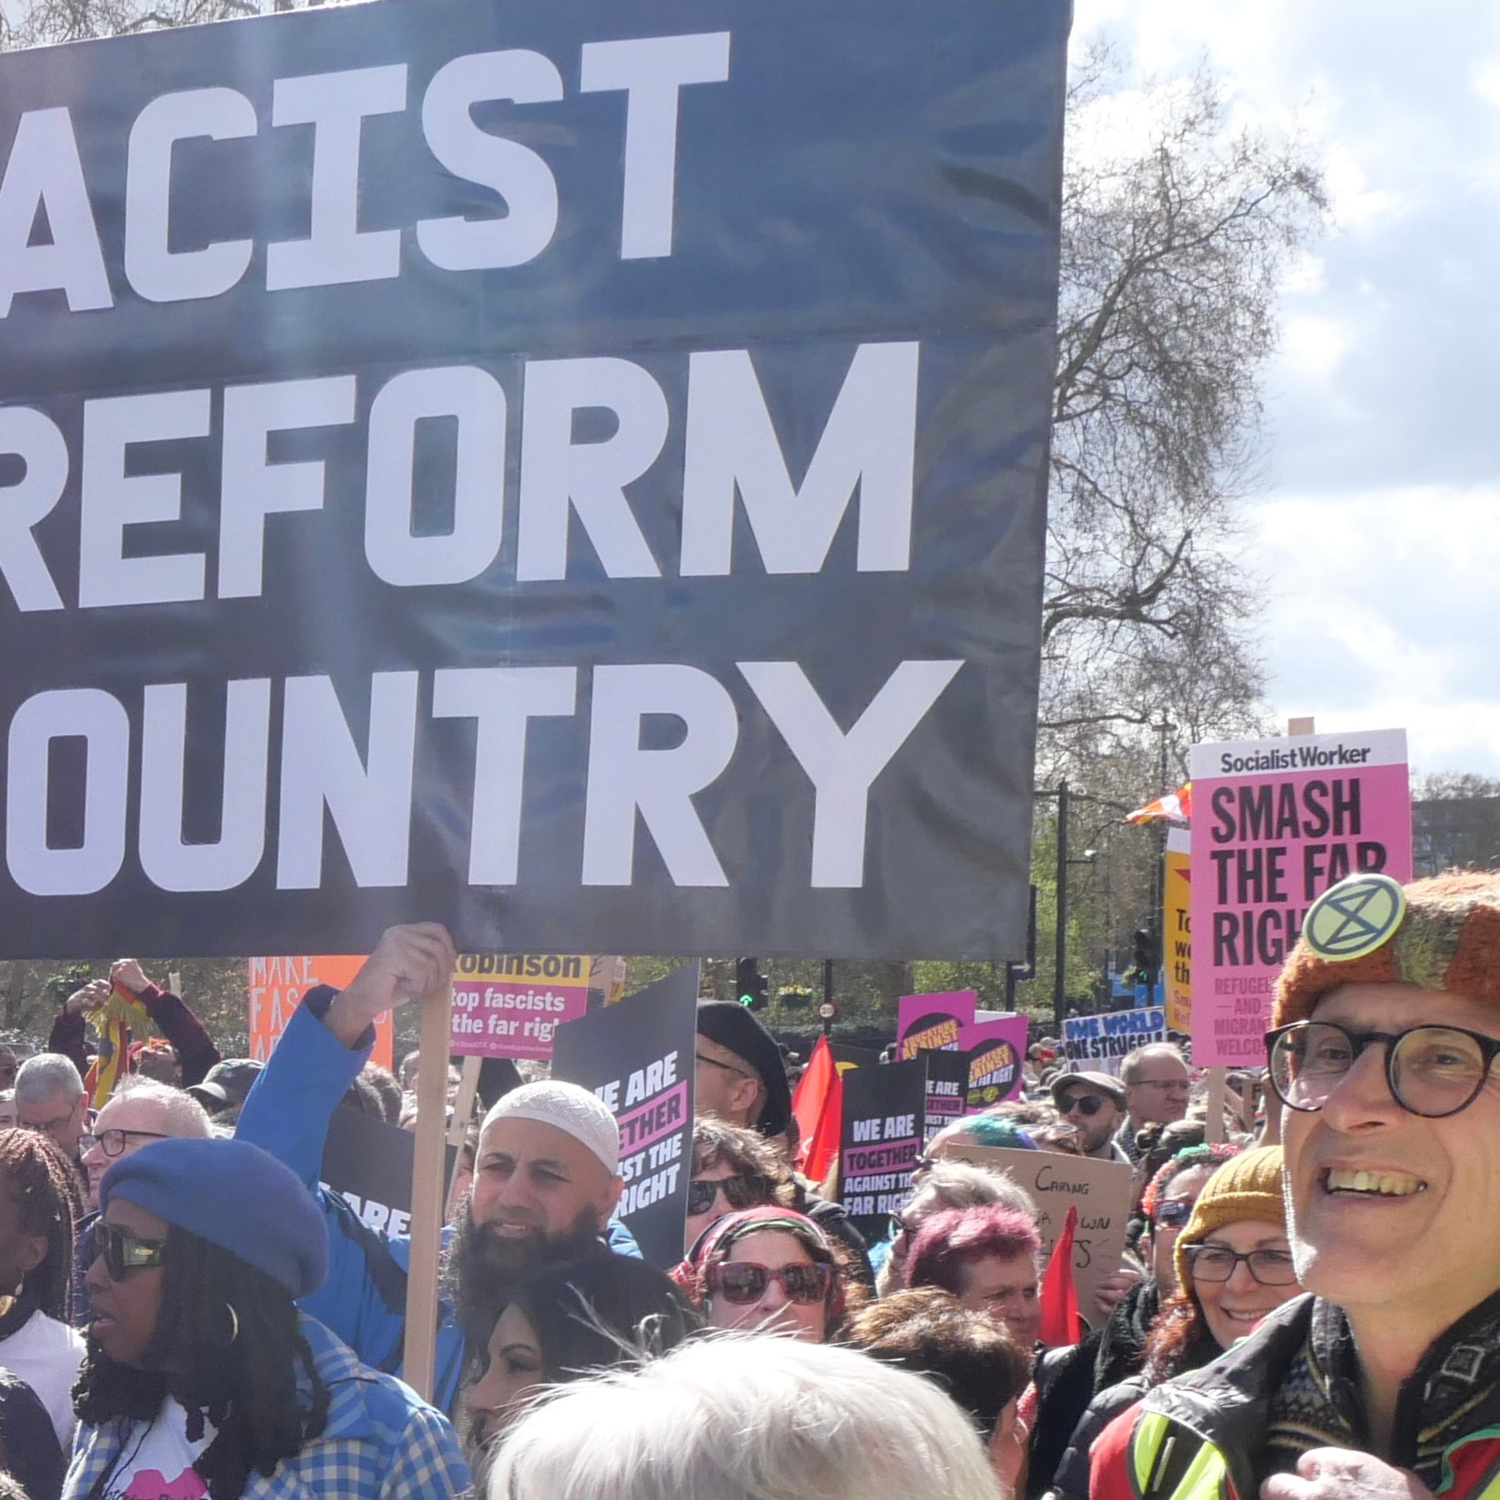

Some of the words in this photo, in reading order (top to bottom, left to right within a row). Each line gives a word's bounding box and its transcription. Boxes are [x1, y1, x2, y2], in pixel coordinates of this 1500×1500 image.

[1221, 749, 1297, 773] Socialist
[1298, 744, 1371, 767] Worker
[1211, 778, 1361, 844] SMASH
[1210, 846, 1288, 905] THE
[251, 955, 319, 986] MAKE
[454, 955, 581, 979] obinson
[451, 987, 479, 1012] top
[484, 988, 565, 1012] fascists
[1234, 998, 1261, 1015] AND
[451, 1013, 483, 1034] the
[488, 1014, 519, 1036] far
[523, 1017, 560, 1043] rig
[1214, 1018, 1267, 1035] MIGRAN
[1215, 1038, 1264, 1056] WELCO
[625, 1051, 678, 1107] ARE
[935, 1081, 959, 1096] ARE
[853, 1118, 881, 1142] WE
[883, 1114, 915, 1139] ARE
[648, 1132, 683, 1169] THE
[847, 1143, 917, 1171] TOGETHER
[844, 1174, 897, 1193] AGAINST
[898, 1172, 913, 1189] TH
[843, 1195, 875, 1215] FAR
